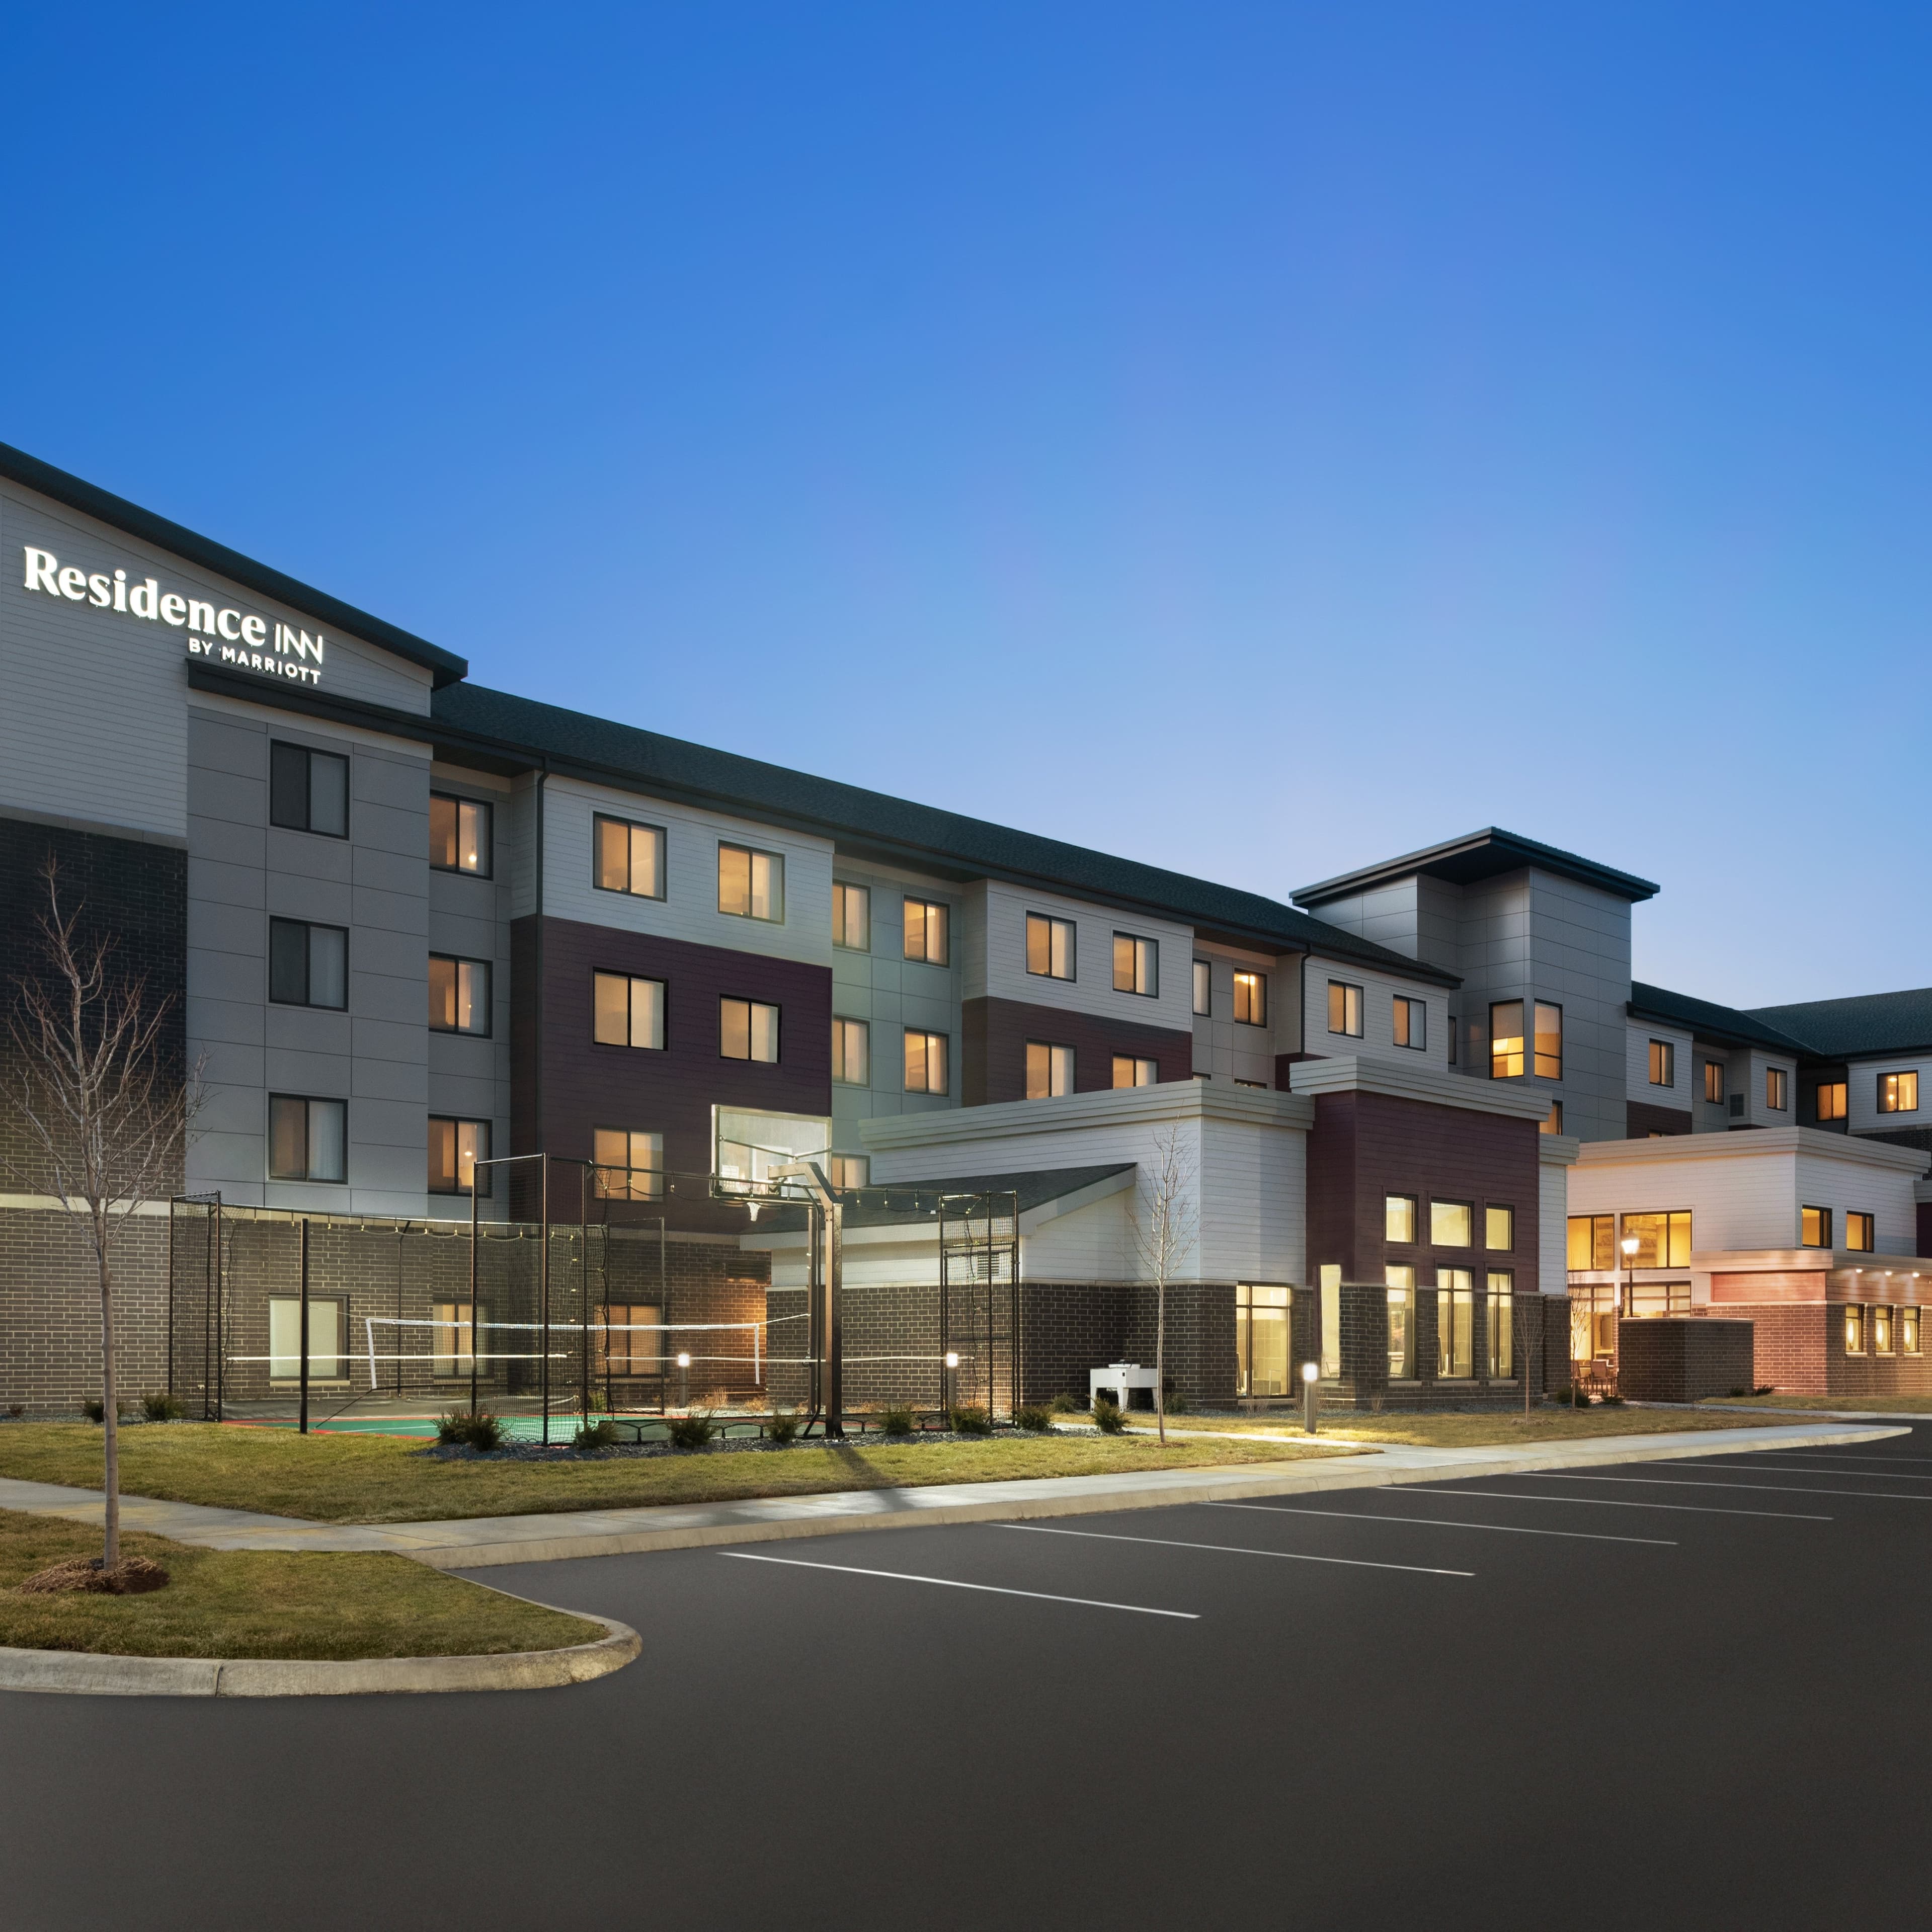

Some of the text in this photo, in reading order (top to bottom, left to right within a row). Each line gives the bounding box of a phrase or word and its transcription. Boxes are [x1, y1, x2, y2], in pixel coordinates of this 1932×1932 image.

[24, 546, 323, 665] Residence INN
[189, 637, 321, 684] BY MARRIOTT
